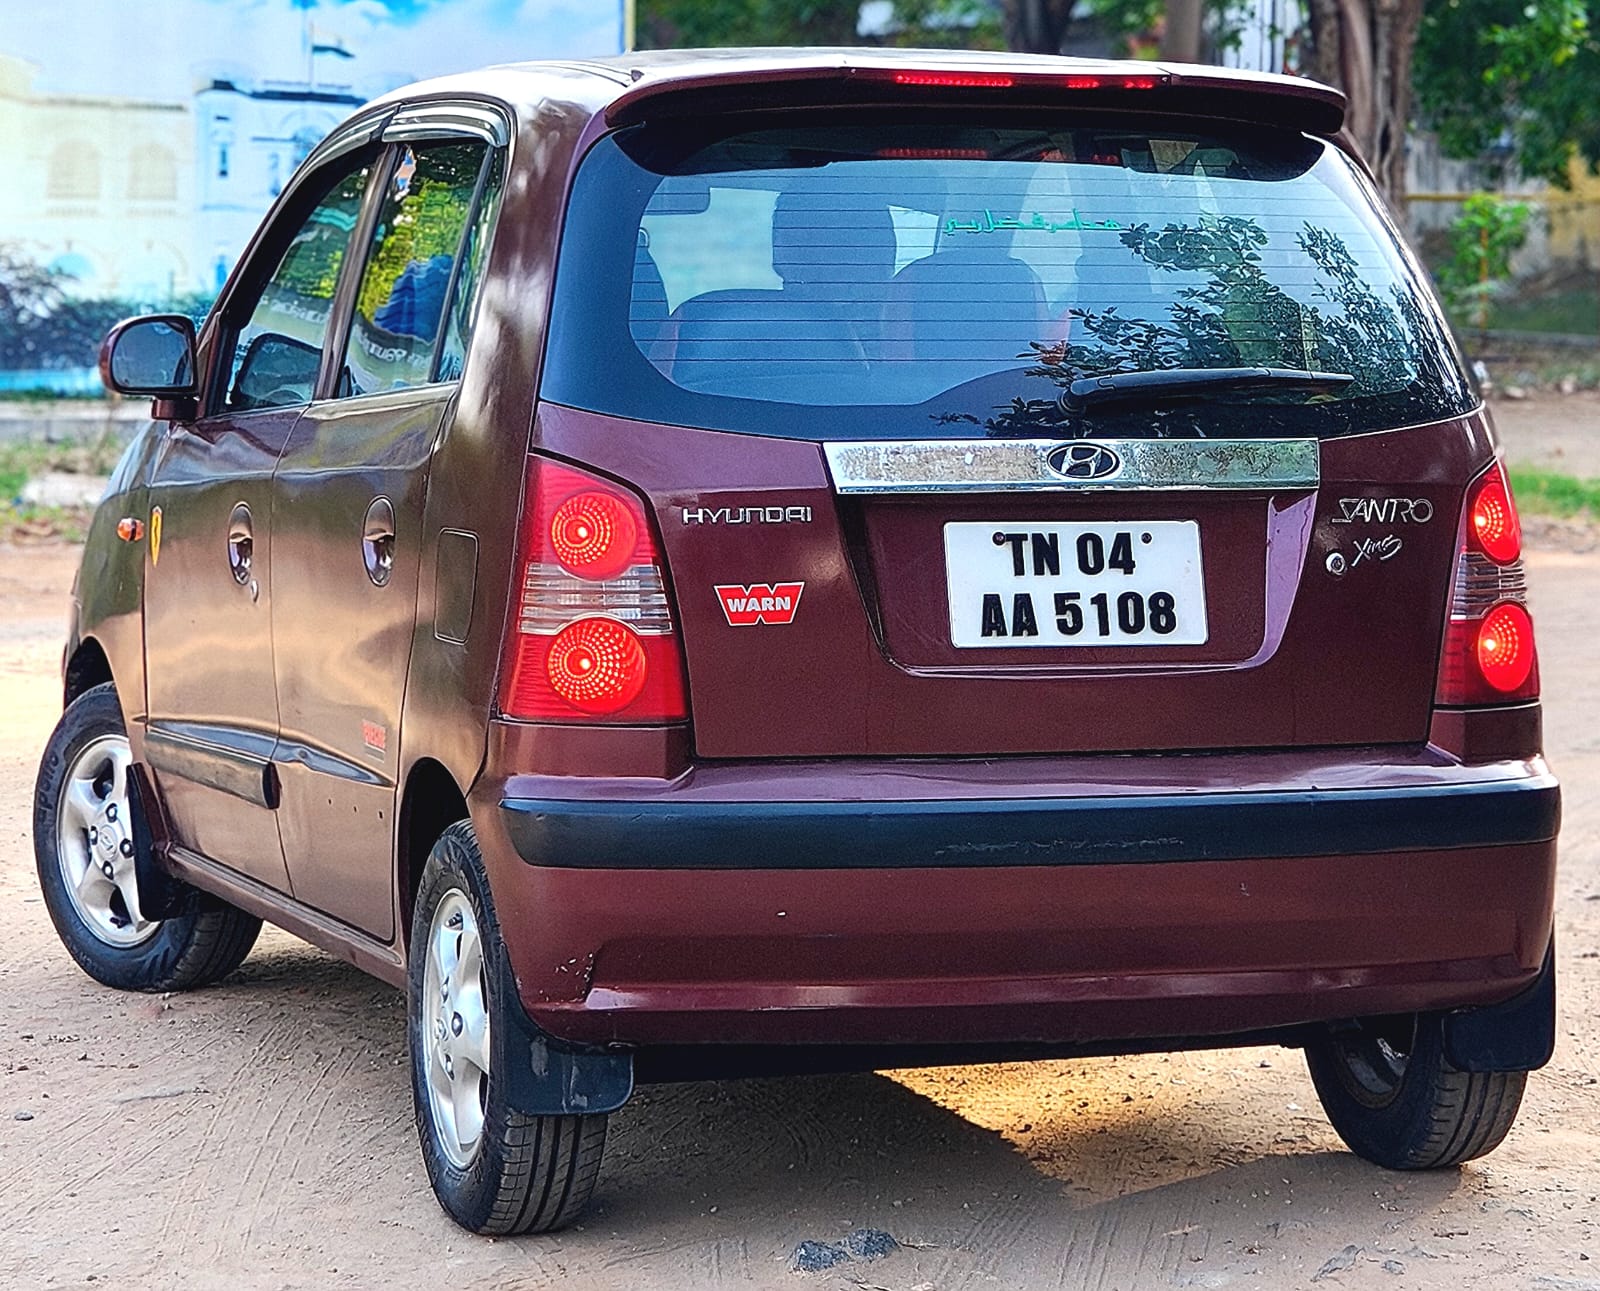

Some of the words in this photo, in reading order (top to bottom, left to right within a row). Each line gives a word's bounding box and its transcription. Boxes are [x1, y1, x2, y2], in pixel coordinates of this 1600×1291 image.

[682, 506, 813, 524] HYUNDAI
[1331, 498, 1434, 523] SANTRO
[1004, 533, 1060, 577] TN
[1075, 532, 1137, 576] 04
[725, 595, 791, 613] WARN
[980, 593, 1039, 638] AA
[1053, 591, 1178, 637] 5108
